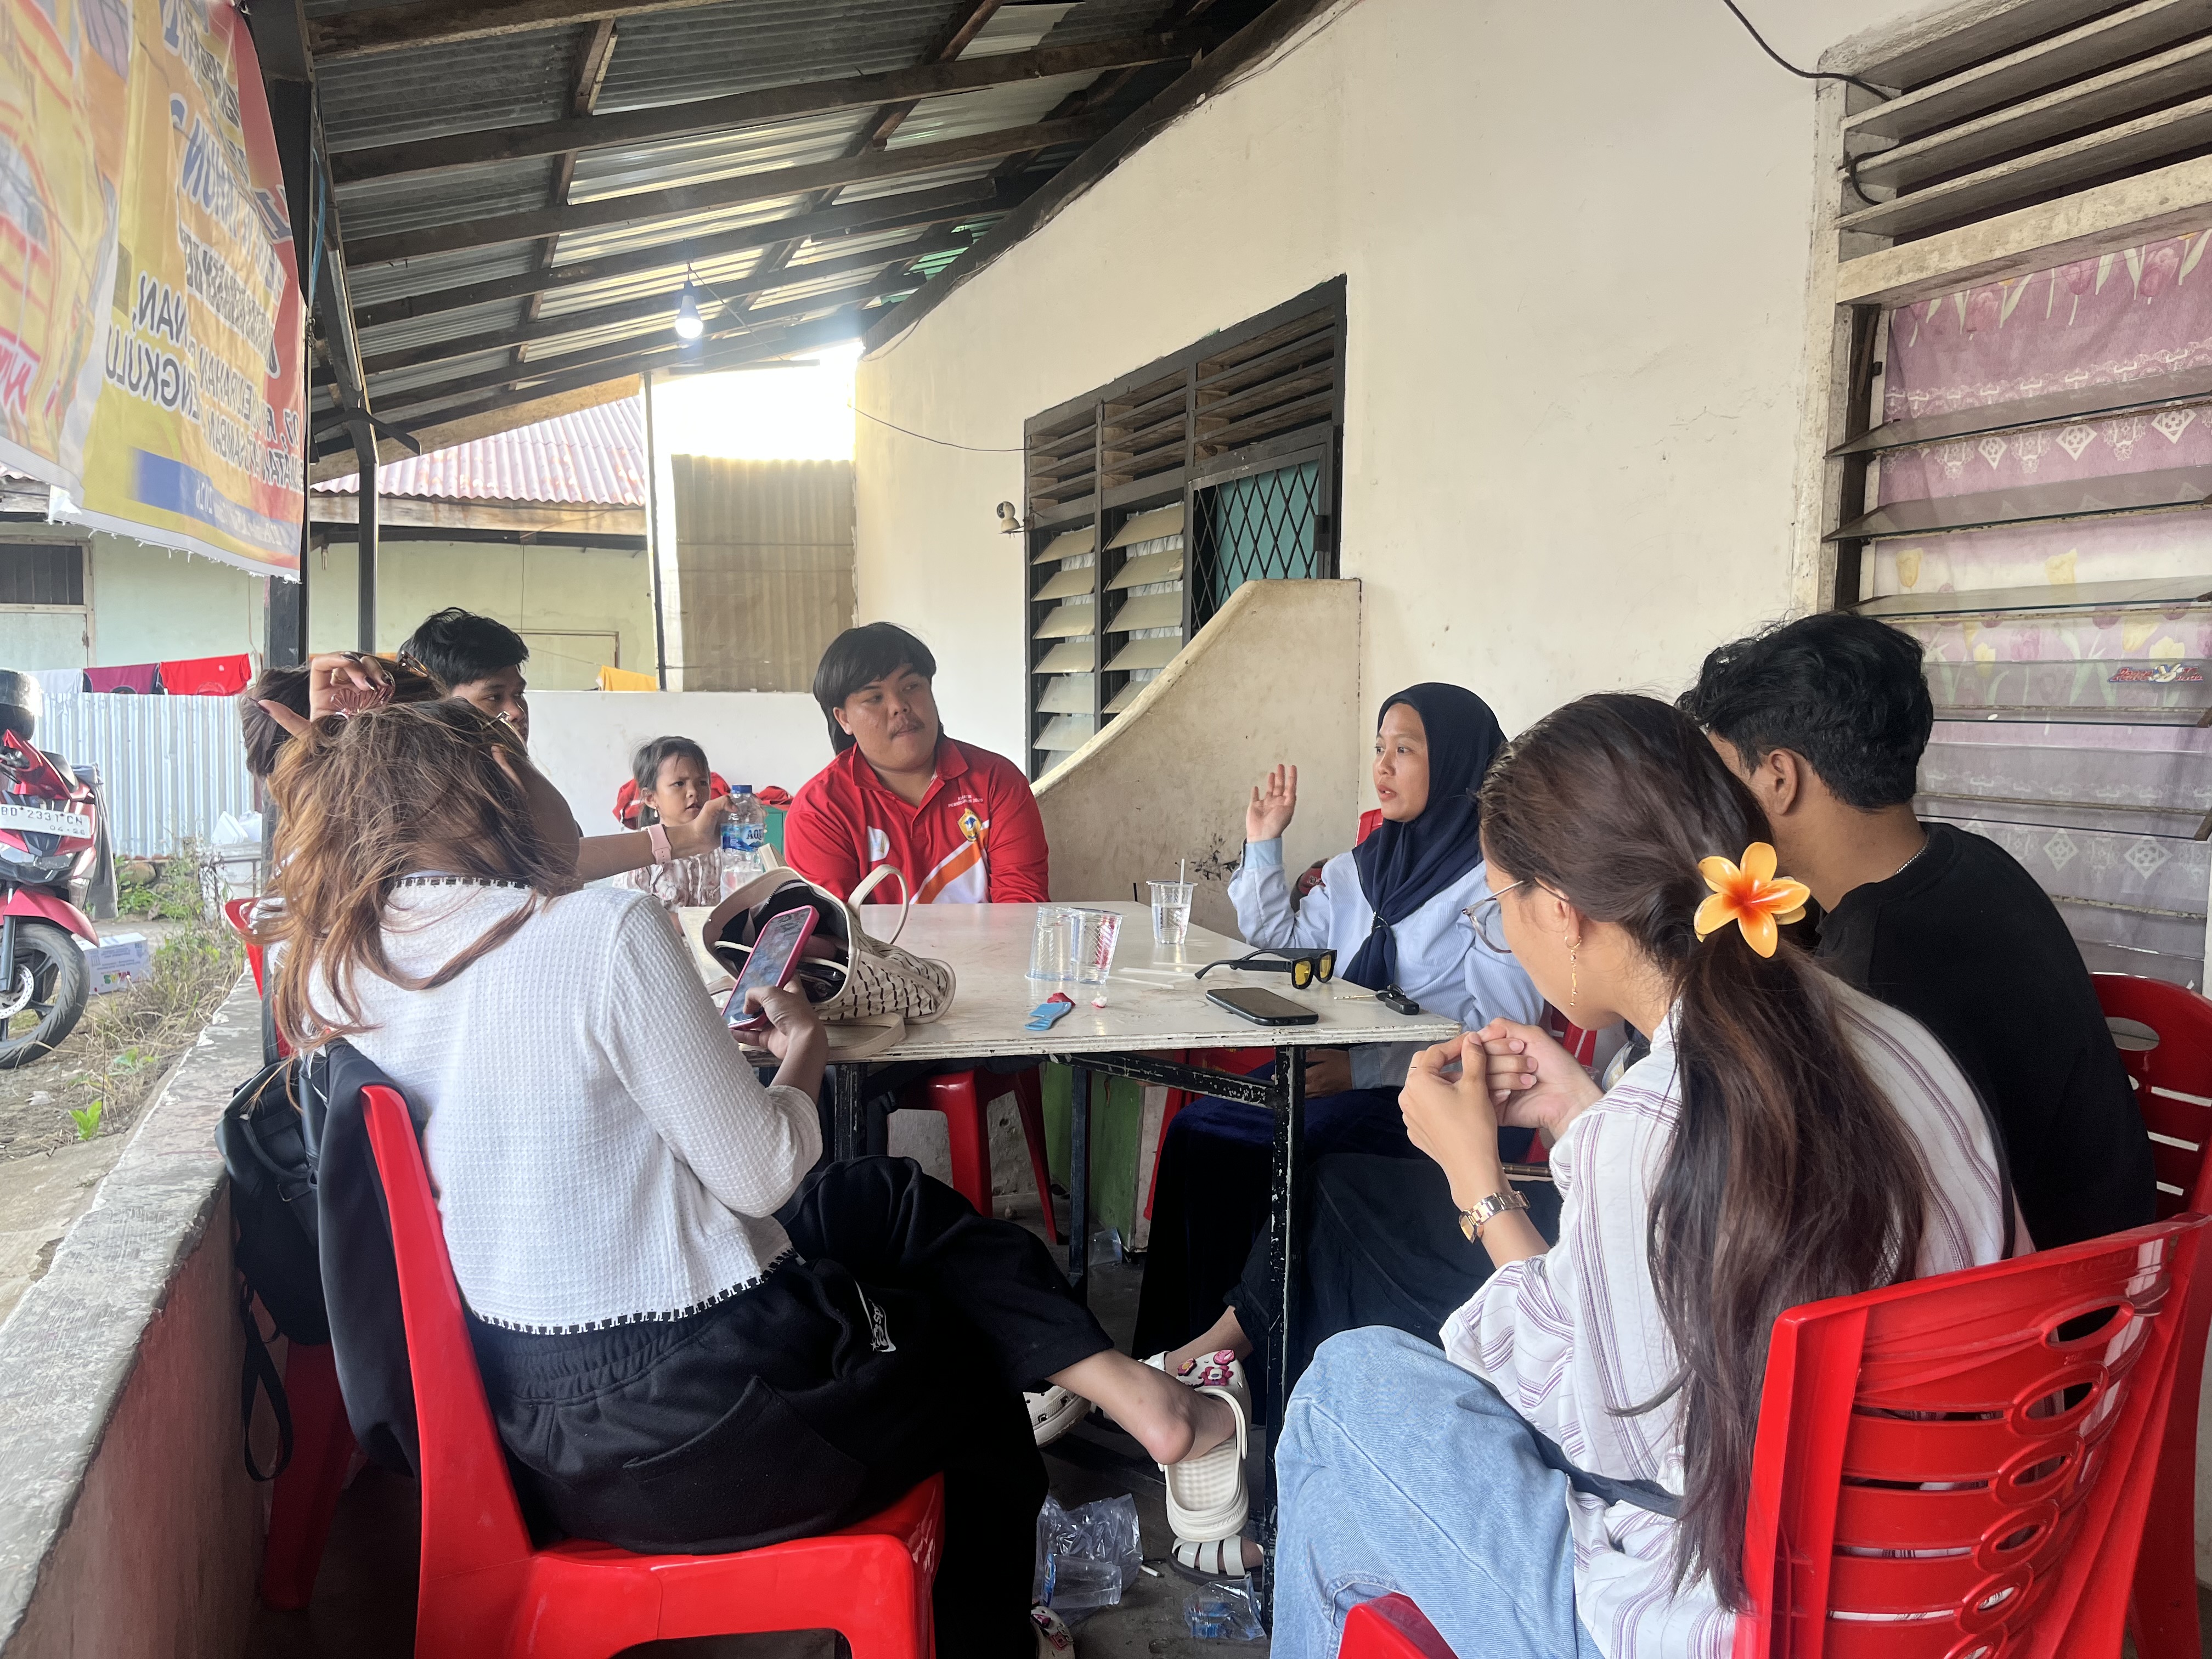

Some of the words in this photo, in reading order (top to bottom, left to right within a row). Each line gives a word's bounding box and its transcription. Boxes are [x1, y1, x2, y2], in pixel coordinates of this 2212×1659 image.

[1, 806, 18, 816] BD
[27, 809, 59, 823] 2331
[66, 815, 83, 825] CN
